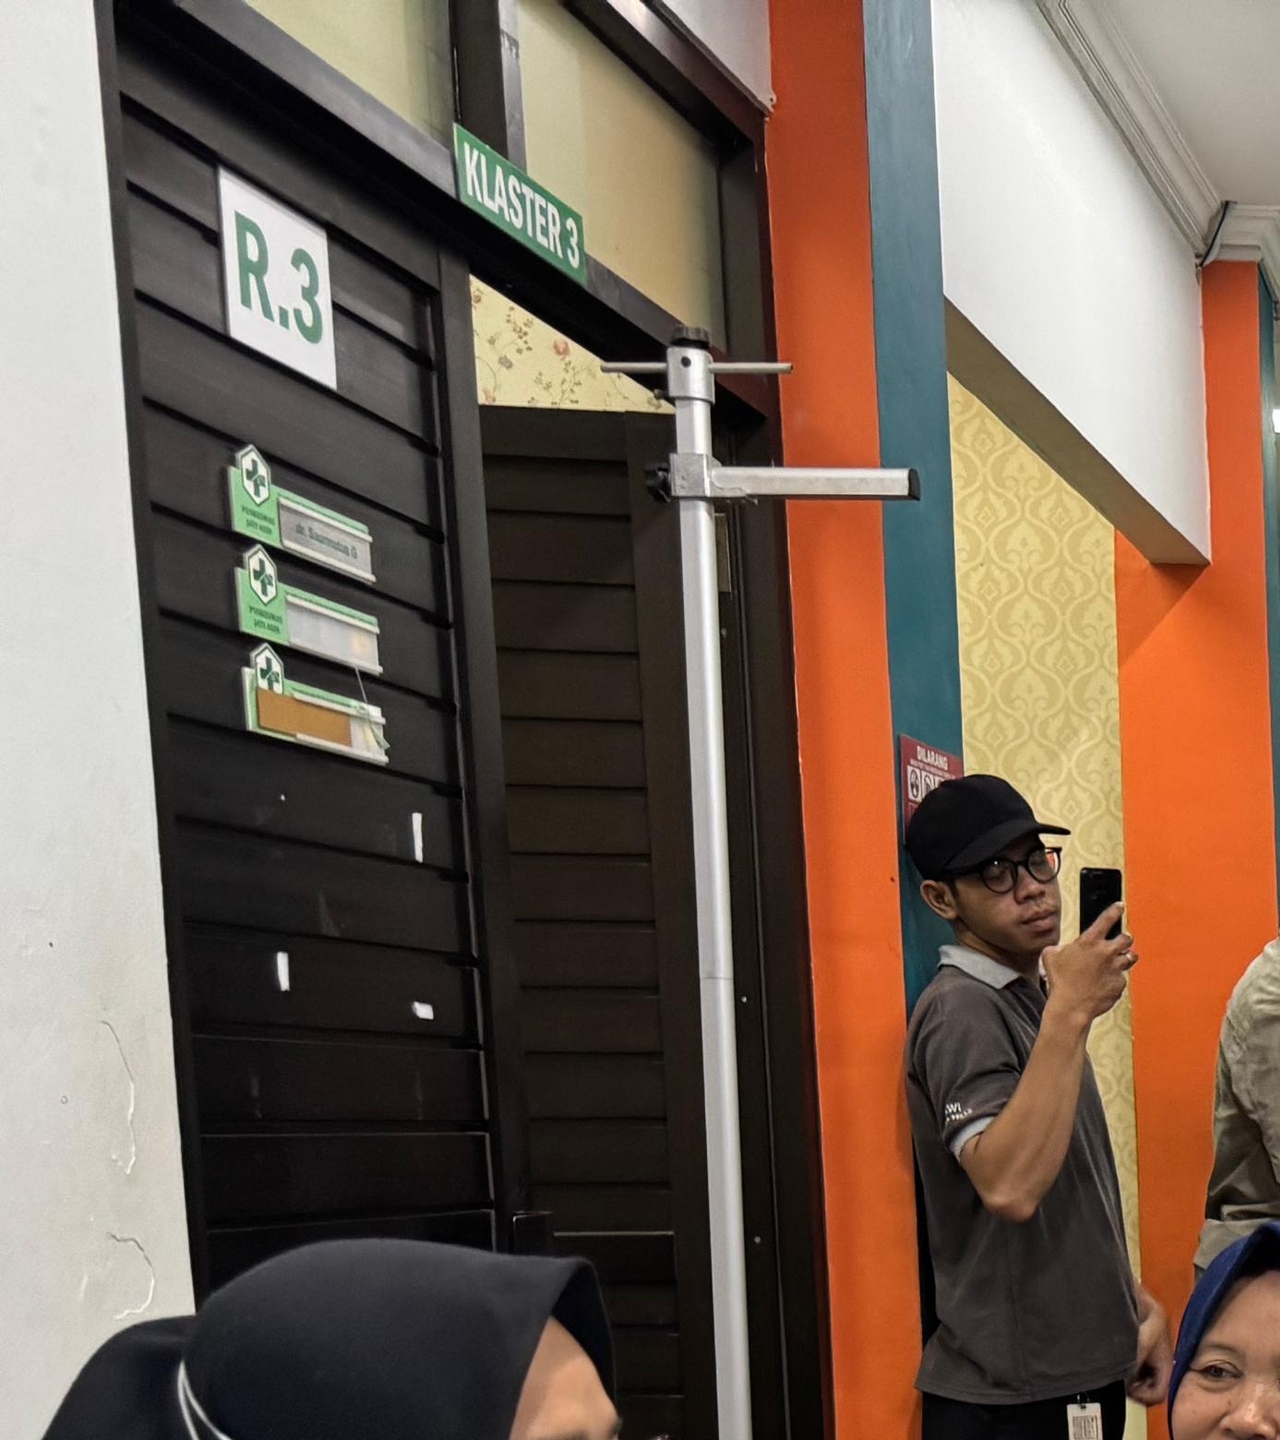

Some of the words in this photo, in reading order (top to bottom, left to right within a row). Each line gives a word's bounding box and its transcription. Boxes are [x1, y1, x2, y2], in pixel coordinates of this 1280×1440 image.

[464, 142, 563, 259] KLASTER
[566, 217, 580, 269] 3
[235, 210, 323, 344] R.3
